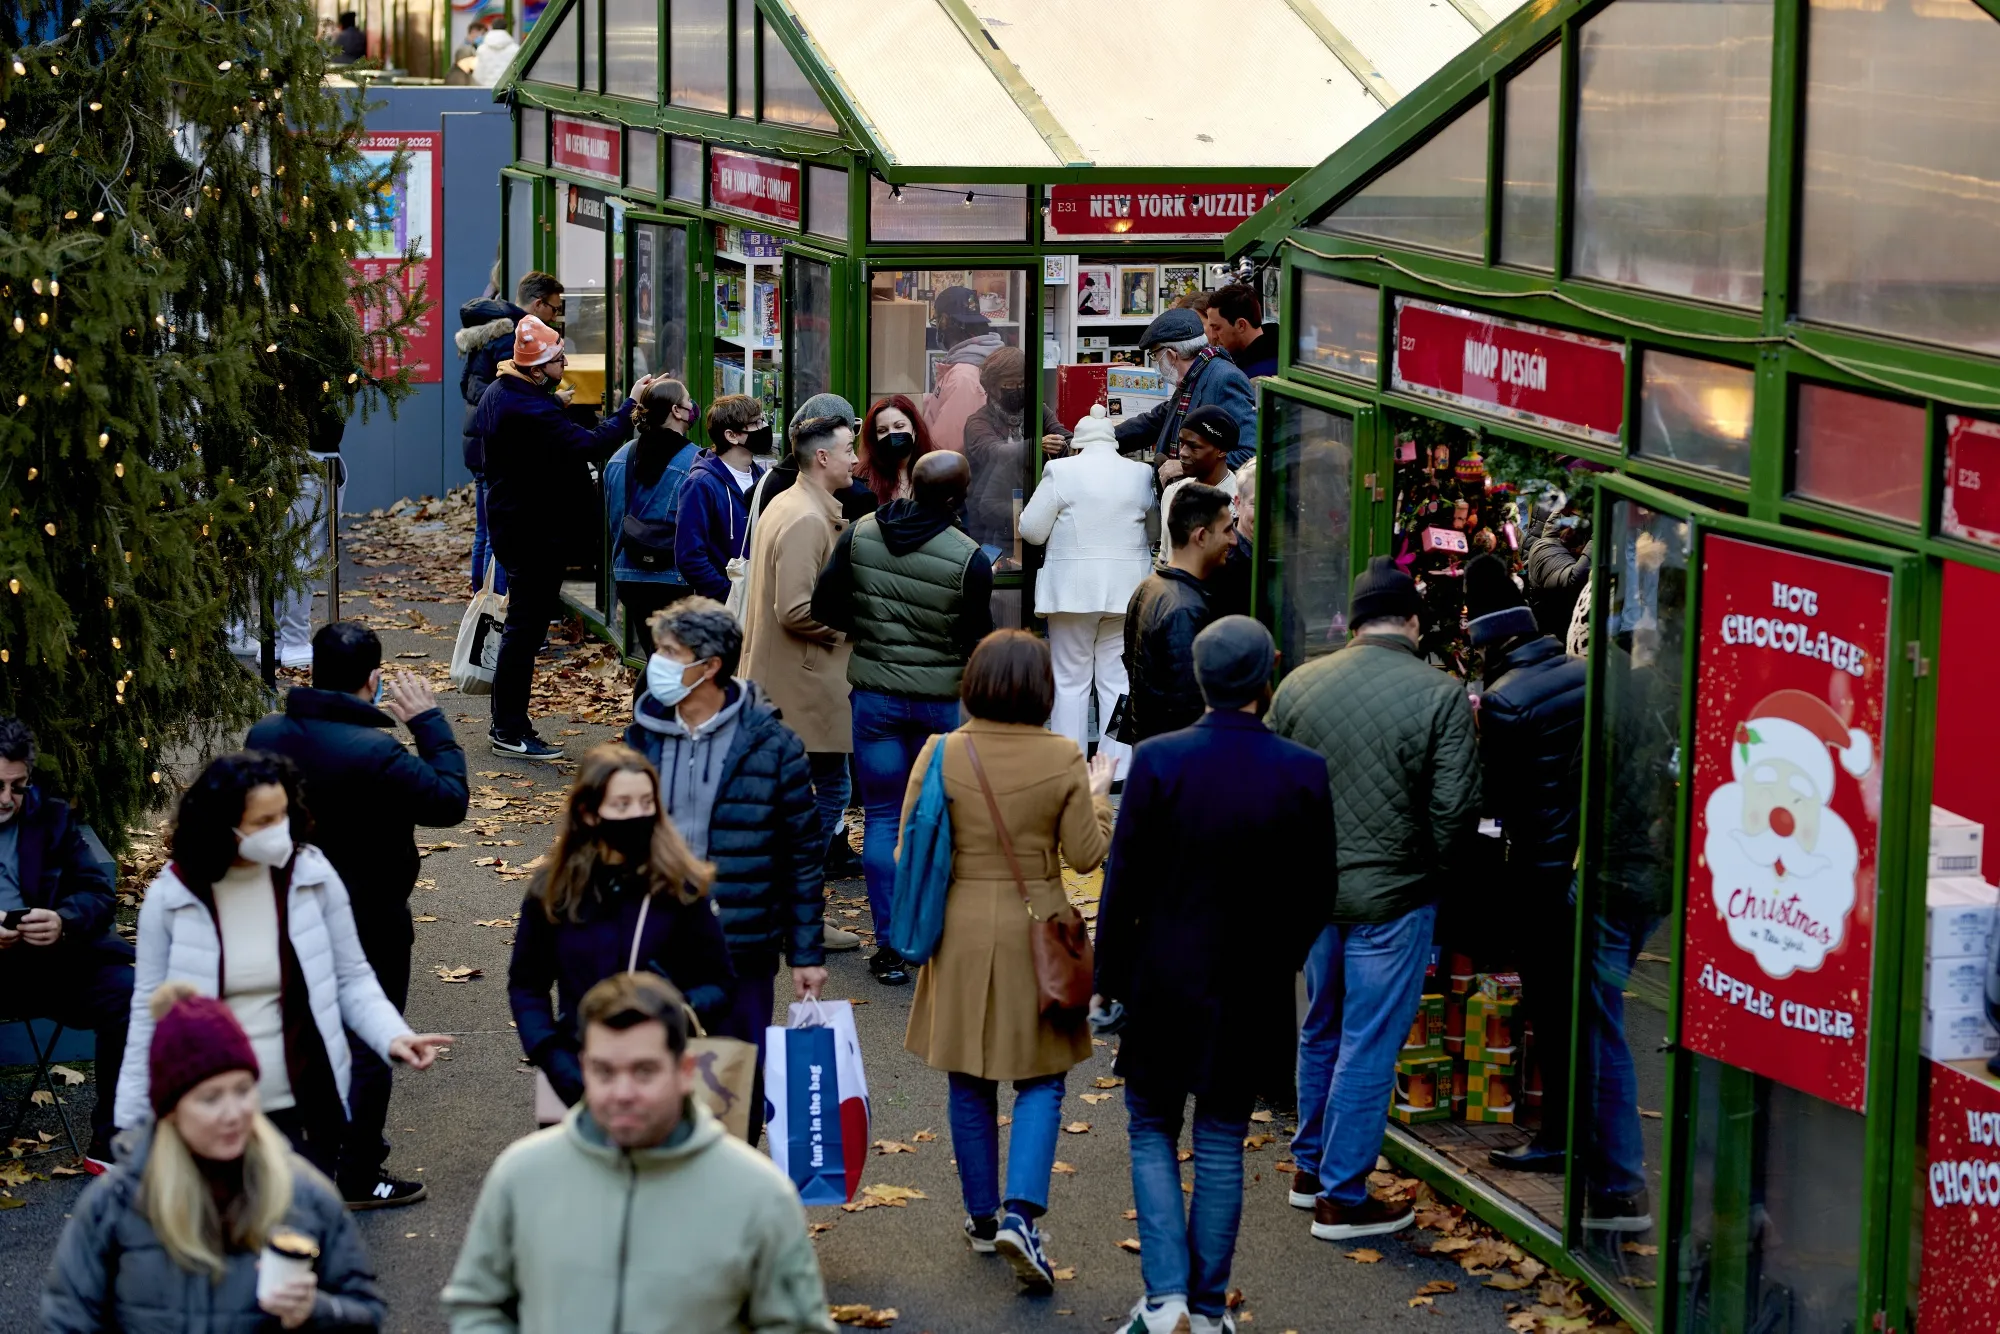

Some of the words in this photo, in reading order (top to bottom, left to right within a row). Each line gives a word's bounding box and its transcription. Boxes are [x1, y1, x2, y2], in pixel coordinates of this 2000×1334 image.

[376, 137, 399, 147] 2021
[407, 137, 432, 147] 2022
[721, 167, 733, 190] NEW
[733, 169, 747, 194] YORK
[747, 172, 766, 198] PUZZLE
[766, 177, 791, 204] COMPANY
[1057, 202, 1077, 212] E31
[1090, 194, 1131, 218] NEW
[1138, 193, 1186, 217] YORK
[1192, 193, 1257, 217] PUZZLE
[1402, 335, 1416, 351] E27
[1464, 339, 1499, 379] NUOP
[1501, 348, 1547, 392] DESIGN
[1771, 581, 1819, 617] HOT
[1721, 614, 1866, 677] CHOCOLATE
[1728, 887, 1833, 945] Christmas
[1697, 963, 1775, 1020] APPLE
[1780, 999, 1855, 1039] CIDER
[808, 1065, 823, 1091] bag
[809, 1092, 821, 1116] the
[810, 1132, 824, 1168] fun's
[372, 1182, 393, 1199] N
[1929, 1158, 2000, 1208] CHOCO
